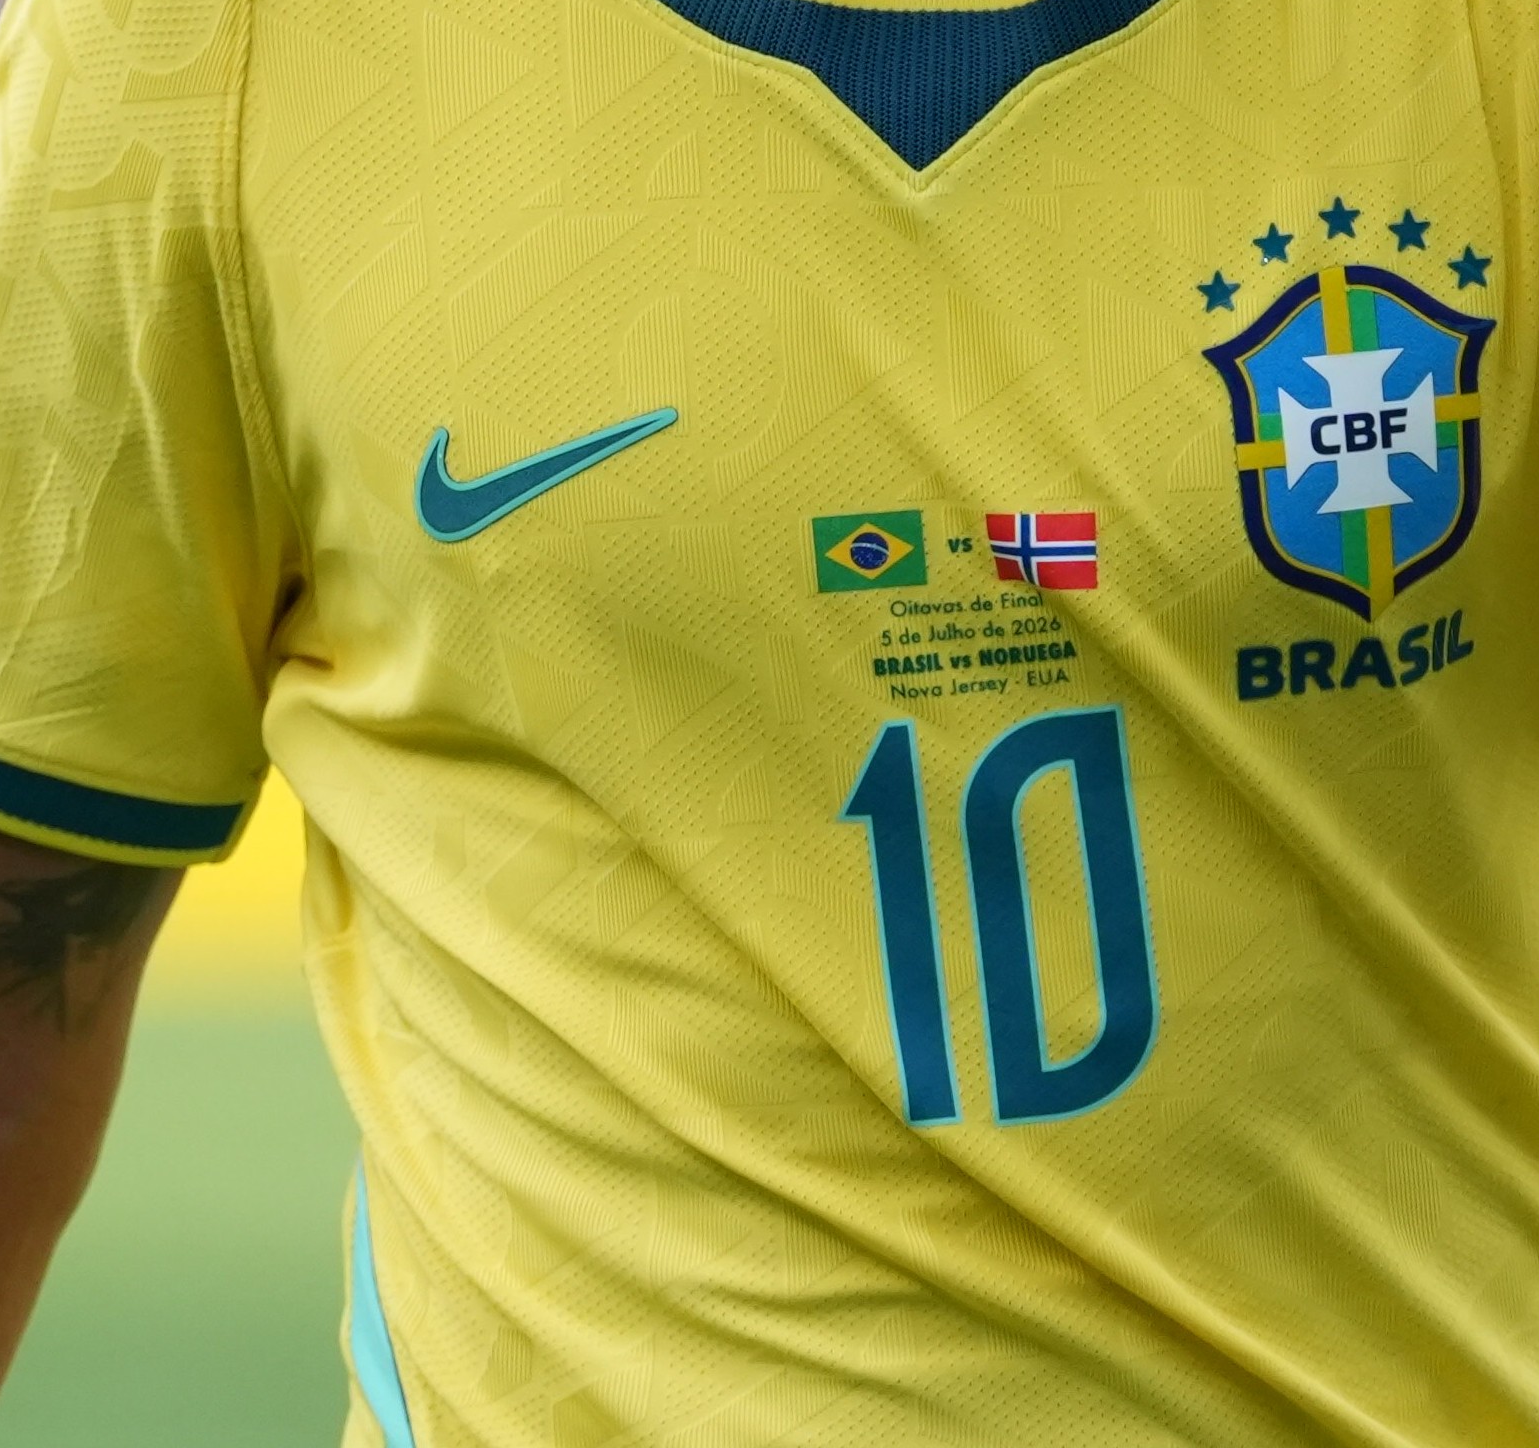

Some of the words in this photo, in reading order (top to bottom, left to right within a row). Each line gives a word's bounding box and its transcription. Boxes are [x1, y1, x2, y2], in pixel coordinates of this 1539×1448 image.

[1309, 407, 1409, 456] CBF
[890, 598, 964, 618] Oitavas
[970, 595, 994, 612] de
[1001, 590, 1043, 609] Final
[881, 630, 892, 647] 5
[899, 626, 922, 645] de
[928, 621, 976, 643] Julho
[982, 620, 1006, 639] de
[1012, 617, 1061, 637] 2026
[873, 653, 943, 676] BRASIL
[978, 640, 1077, 667] NORUEGA
[1237, 608, 1476, 702] BRASIL
[890, 683, 943, 700] Nova
[949, 675, 1009, 697] Jersey
[1026, 669, 1070, 687] EUA
[837, 702, 1161, 1128] 10
